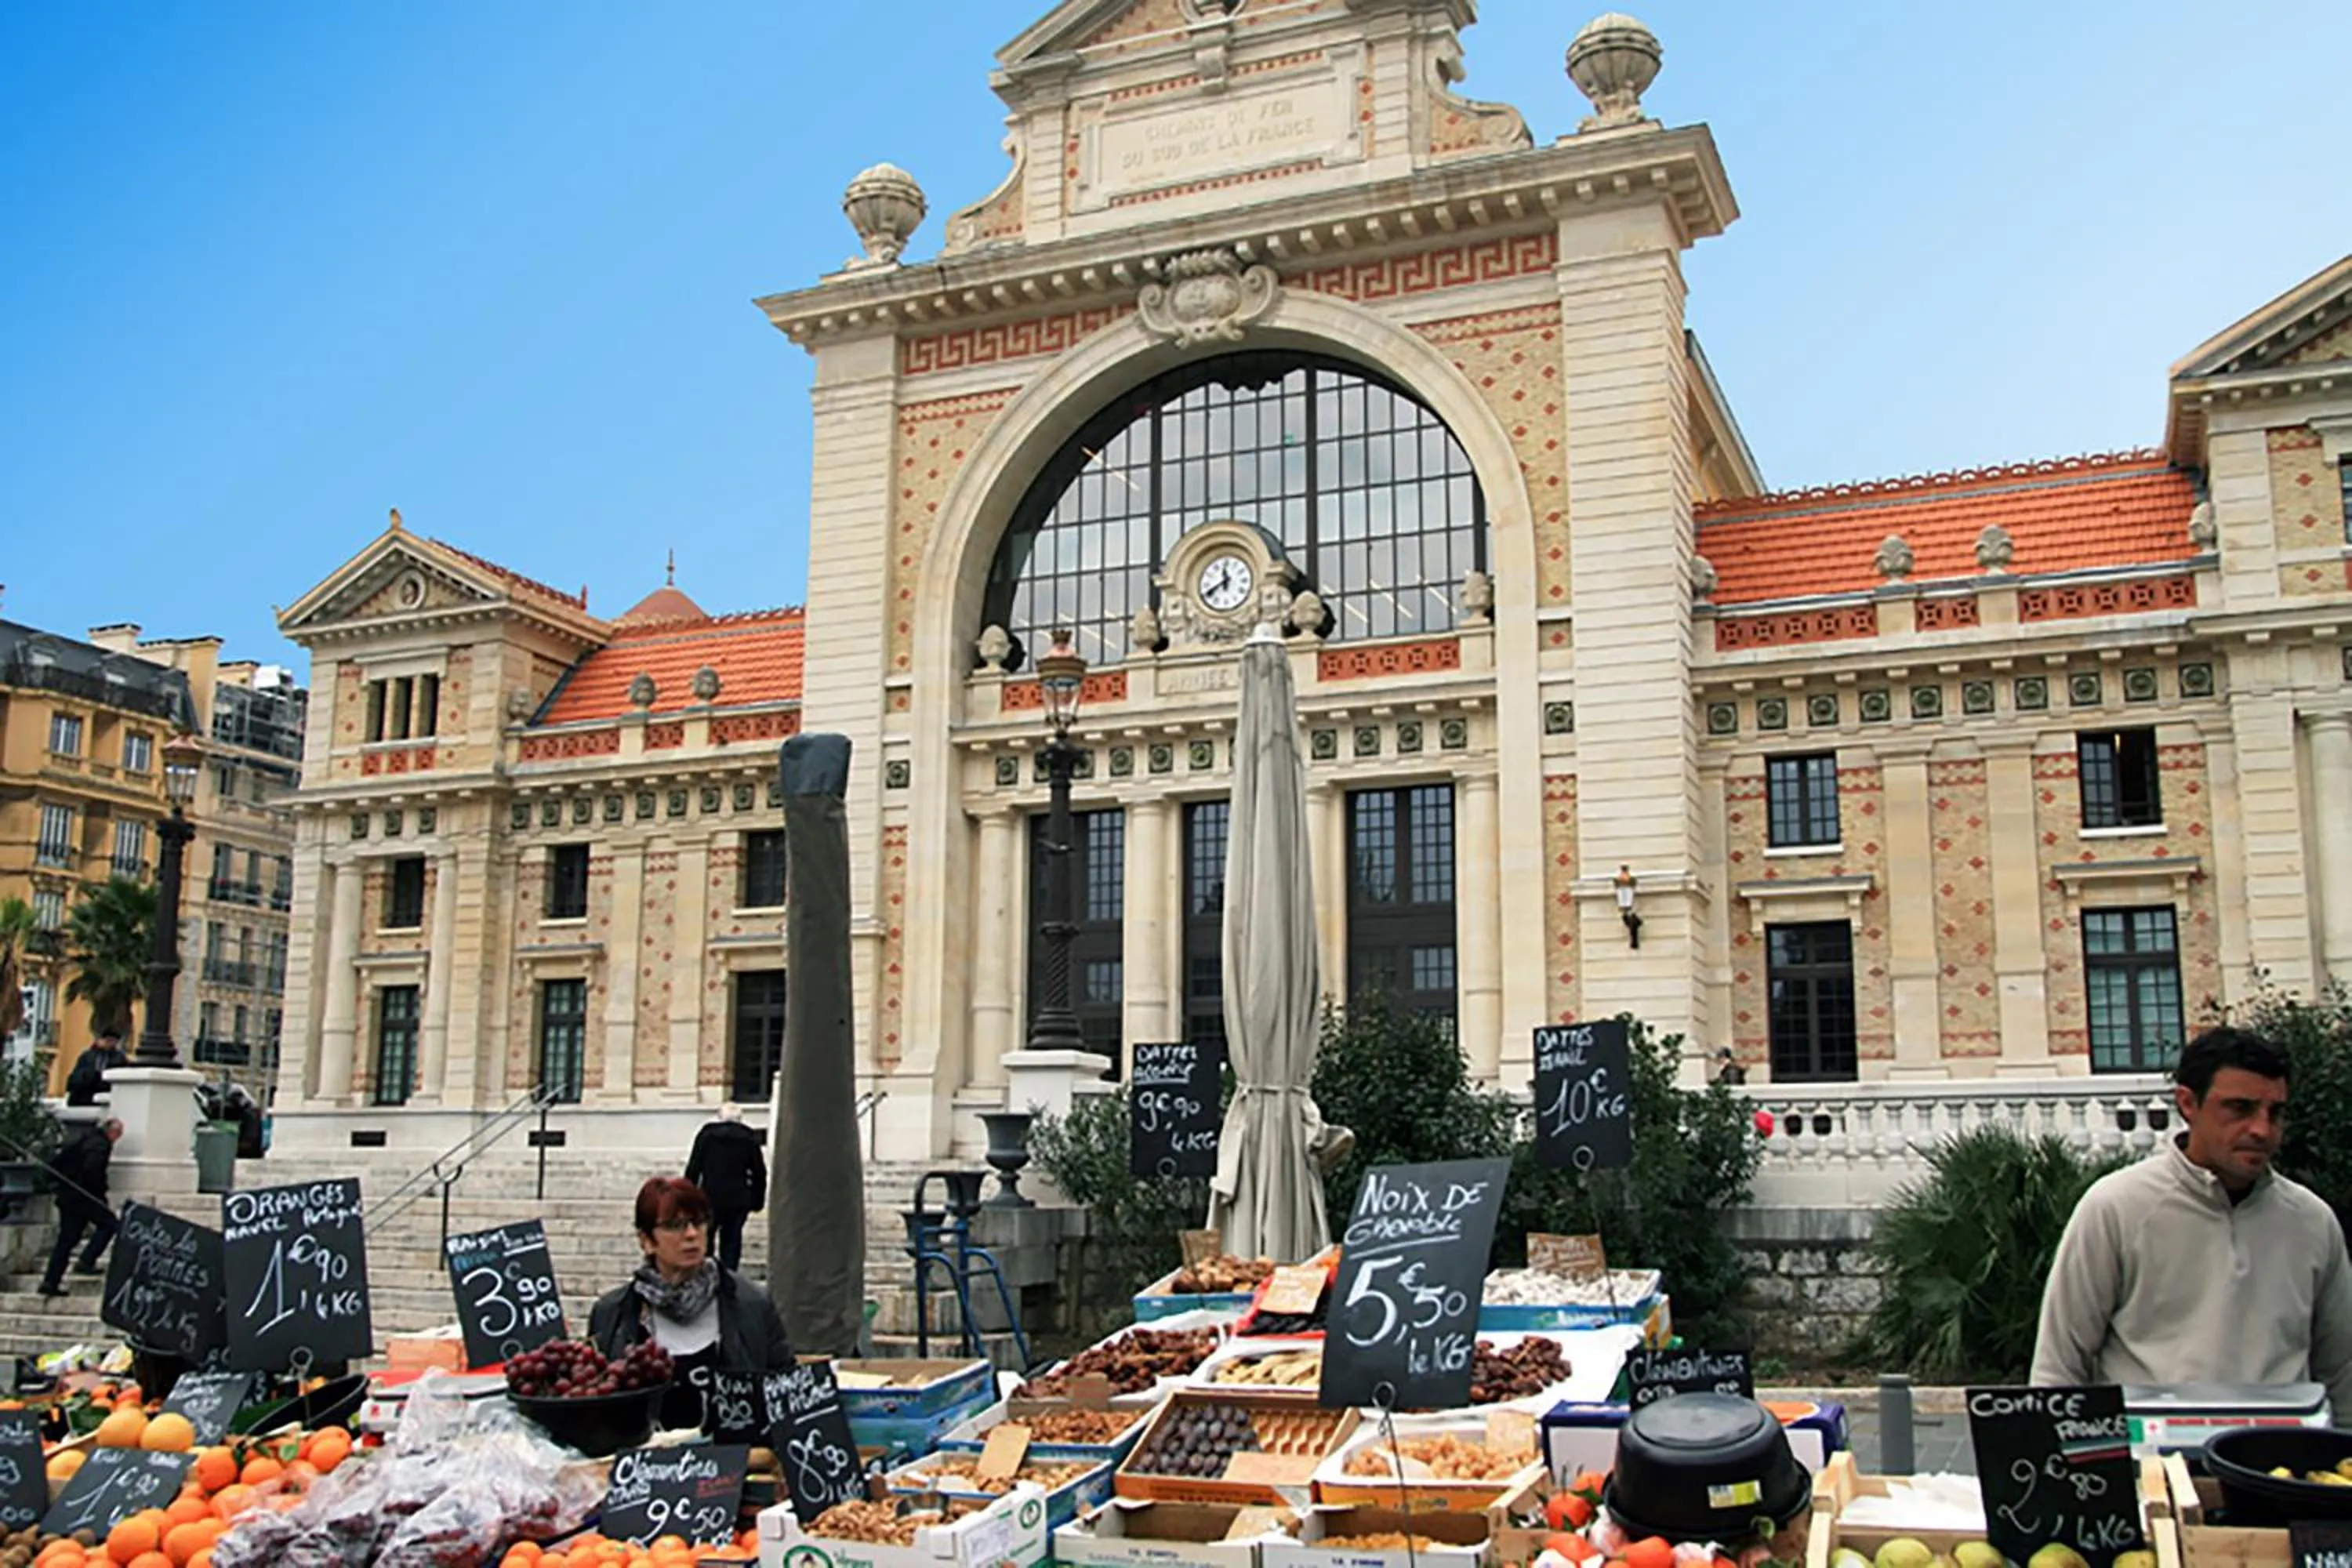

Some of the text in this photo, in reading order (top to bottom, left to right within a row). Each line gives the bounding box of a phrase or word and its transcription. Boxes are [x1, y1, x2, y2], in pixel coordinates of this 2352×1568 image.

[1595, 1093, 1625, 1119] KG
[224, 1182, 346, 1224] ORANGES
[1441, 1181, 1489, 1211] DE
[330, 1290, 364, 1315] KG
[1433, 1332, 1472, 1373] KG
[1969, 1392, 2088, 1418] COMiCE
[2053, 1414, 2128, 1441] FRANCE
[2096, 1513, 2136, 1549] KG
